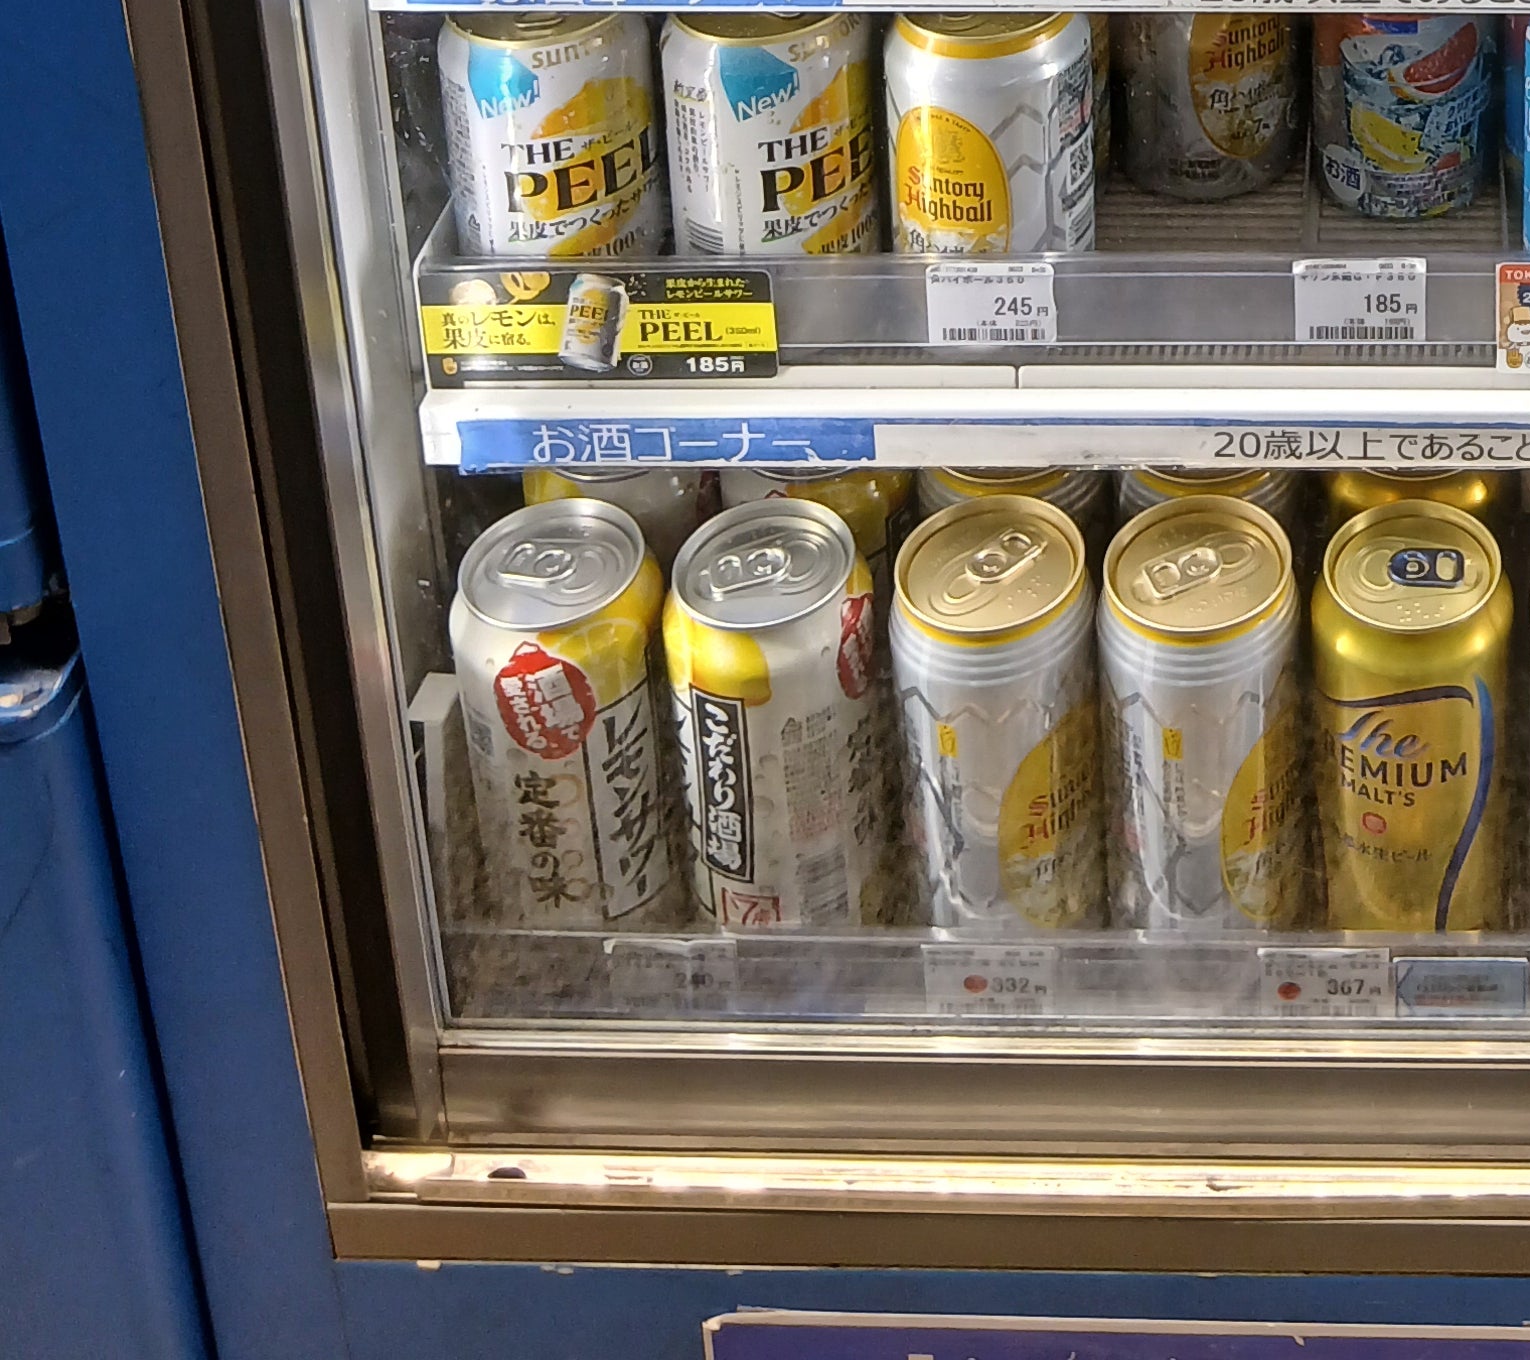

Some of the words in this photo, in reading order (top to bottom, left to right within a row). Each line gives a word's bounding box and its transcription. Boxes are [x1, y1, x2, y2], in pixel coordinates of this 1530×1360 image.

[736, 75, 799, 122] New!
[501, 138, 574, 167] THE
[757, 134, 828, 166] THE
[904, 183, 993, 225] Highball
[640, 322, 723, 343] PEEL
[641, 310, 672, 320] THE
[530, 420, 815, 465] お酒コーナー
[512, 770, 578, 908] 定番の味
